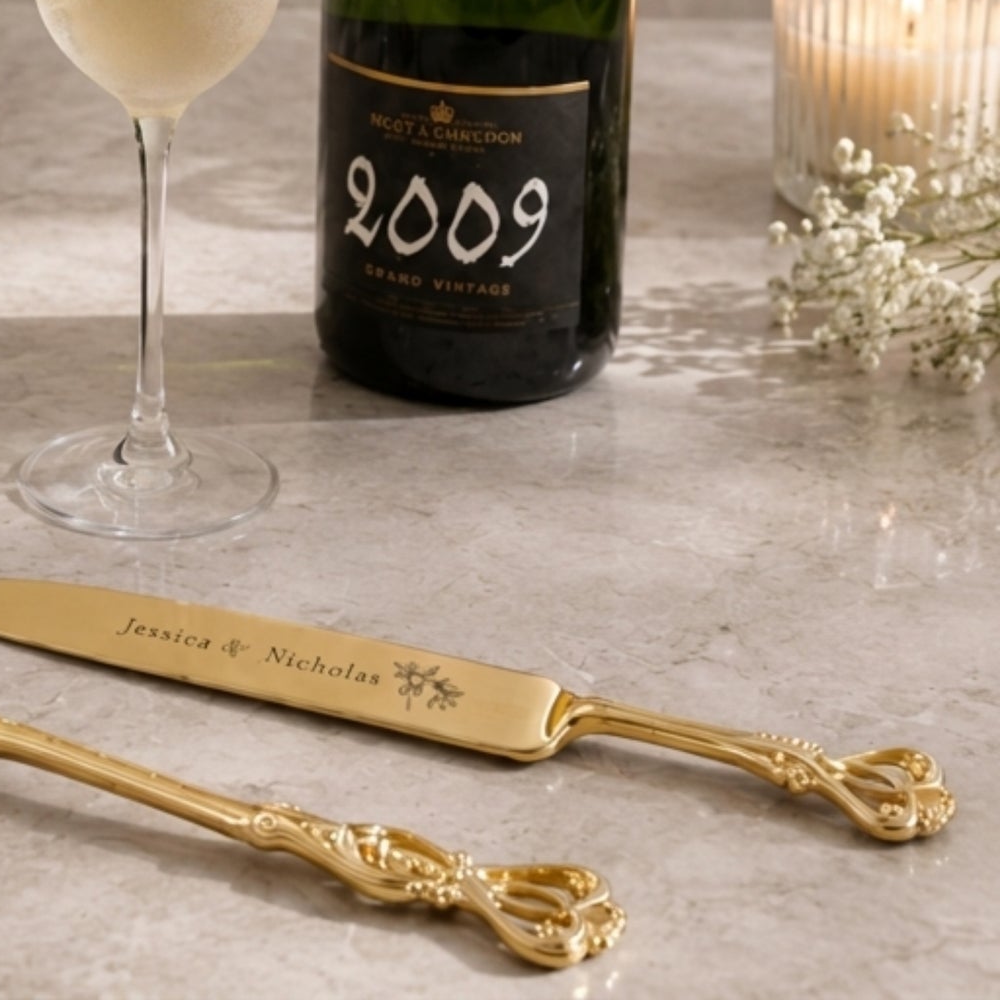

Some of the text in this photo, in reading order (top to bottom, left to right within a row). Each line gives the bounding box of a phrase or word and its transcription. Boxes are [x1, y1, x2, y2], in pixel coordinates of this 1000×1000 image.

[344, 155, 549, 268] 2009
[115, 617, 211, 651] Jessica
[264, 645, 381, 686] Nicholas
